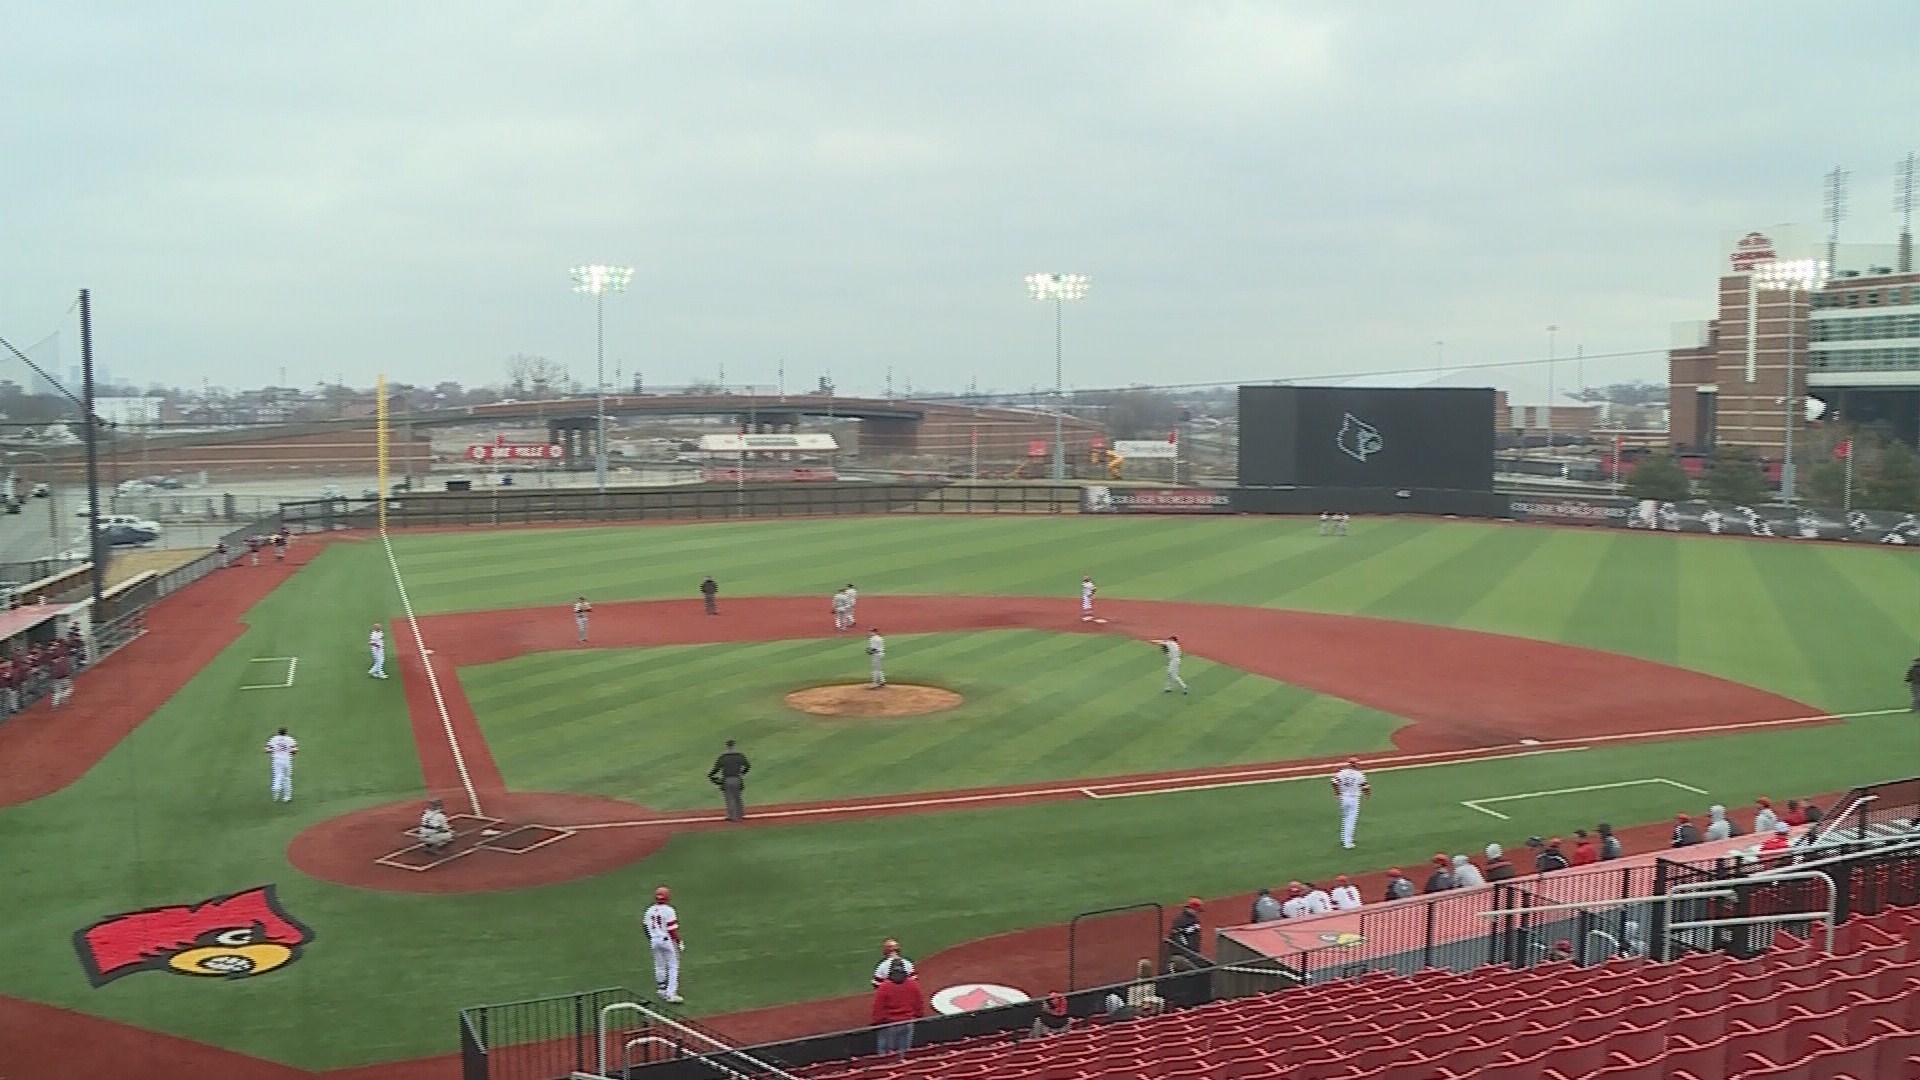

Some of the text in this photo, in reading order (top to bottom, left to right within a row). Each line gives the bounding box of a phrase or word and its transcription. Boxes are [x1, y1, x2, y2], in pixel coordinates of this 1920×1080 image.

[514, 447, 543, 457] VILLE
[1110, 495, 1230, 505] COLLEGE WORLD SERIES
[1510, 502, 1554, 515] COLLEGE
[1555, 504, 1591, 516] WORLD
[1591, 507, 1626, 517] SERIES
